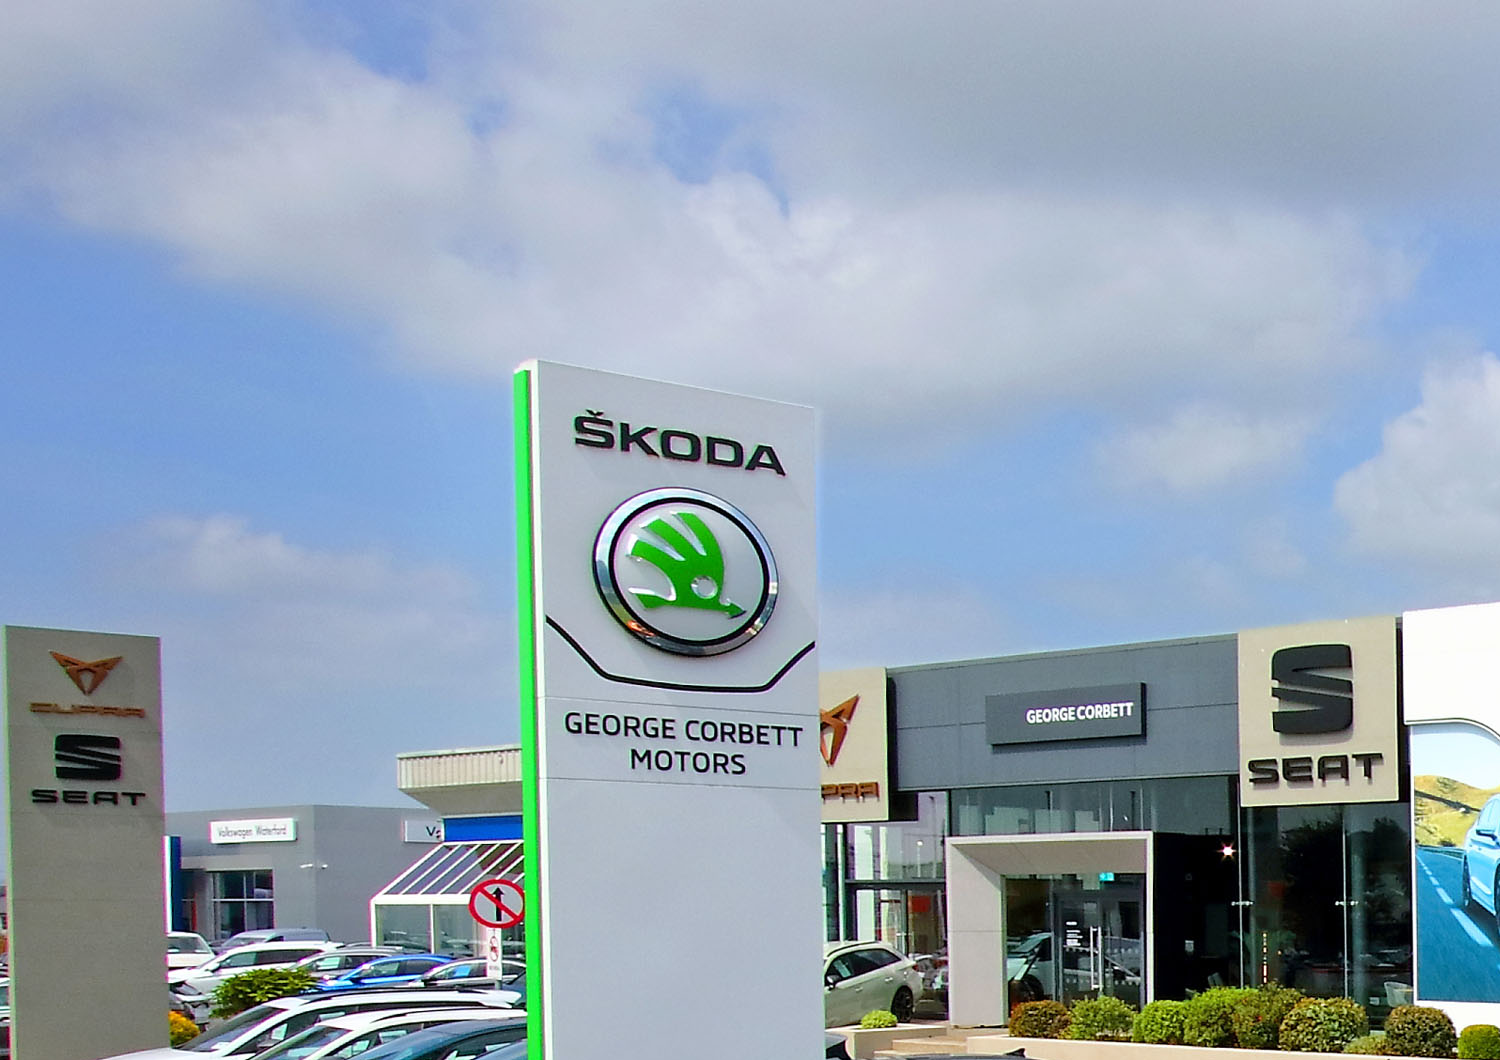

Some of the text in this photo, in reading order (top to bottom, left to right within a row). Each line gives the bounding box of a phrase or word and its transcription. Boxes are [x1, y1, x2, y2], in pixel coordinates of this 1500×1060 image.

[574, 410, 786, 476] ŠKODA
[1026, 702, 1134, 724] GEORGE CORBETT
[565, 712, 803, 748] GEORGE CORBETT
[631, 749, 747, 775] MOTORS
[1249, 753, 1384, 784] SEAT
[32, 789, 146, 806] SEAT
[820, 782, 880, 800] PRA
